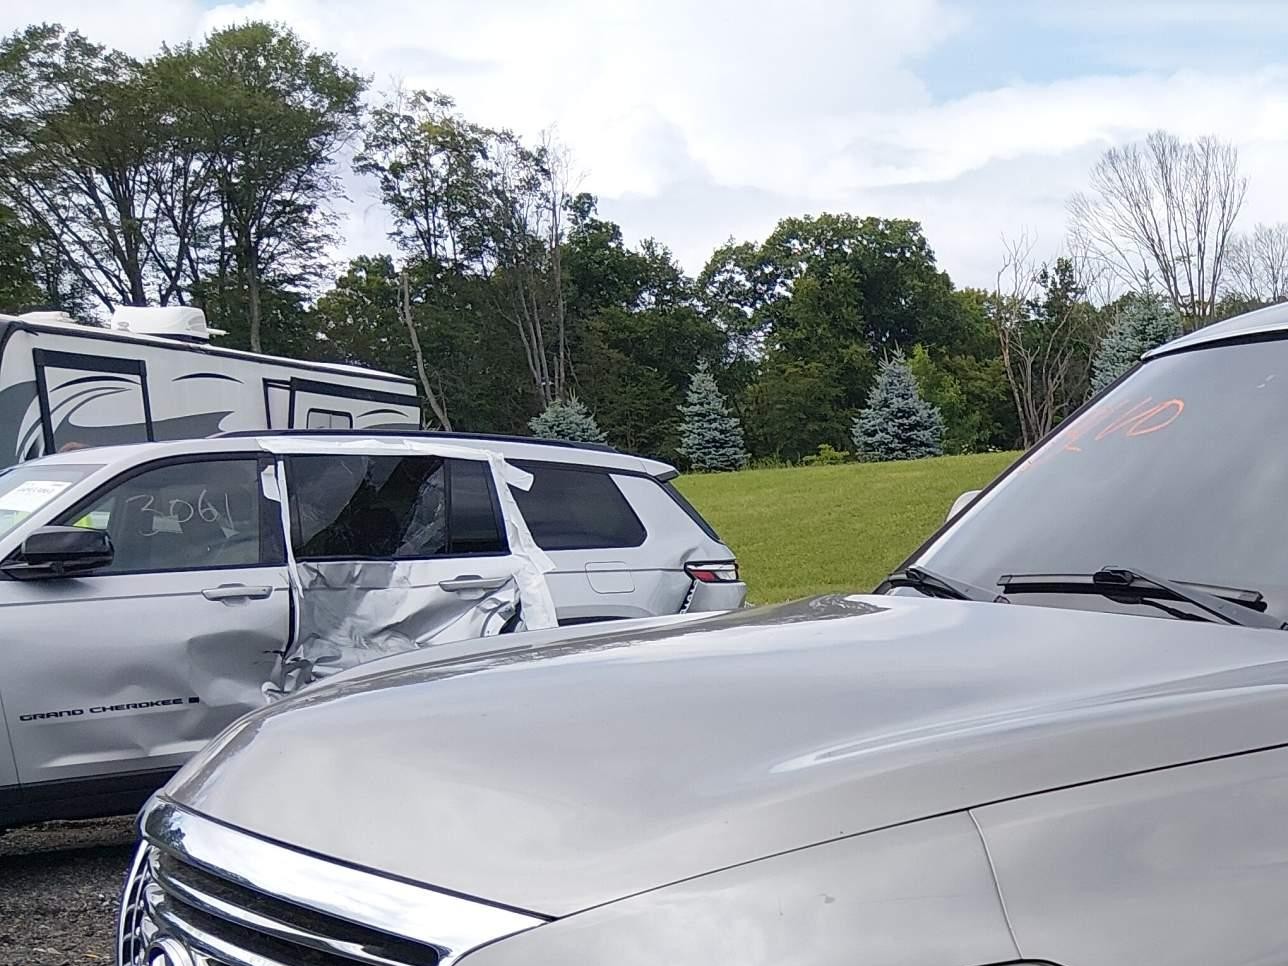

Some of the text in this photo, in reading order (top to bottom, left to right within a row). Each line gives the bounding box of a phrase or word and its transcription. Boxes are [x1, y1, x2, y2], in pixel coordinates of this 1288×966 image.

[125, 489, 235, 537] 3061
[19, 708, 84, 722] GRAND
[88, 697, 184, 714] CHEROKEE
